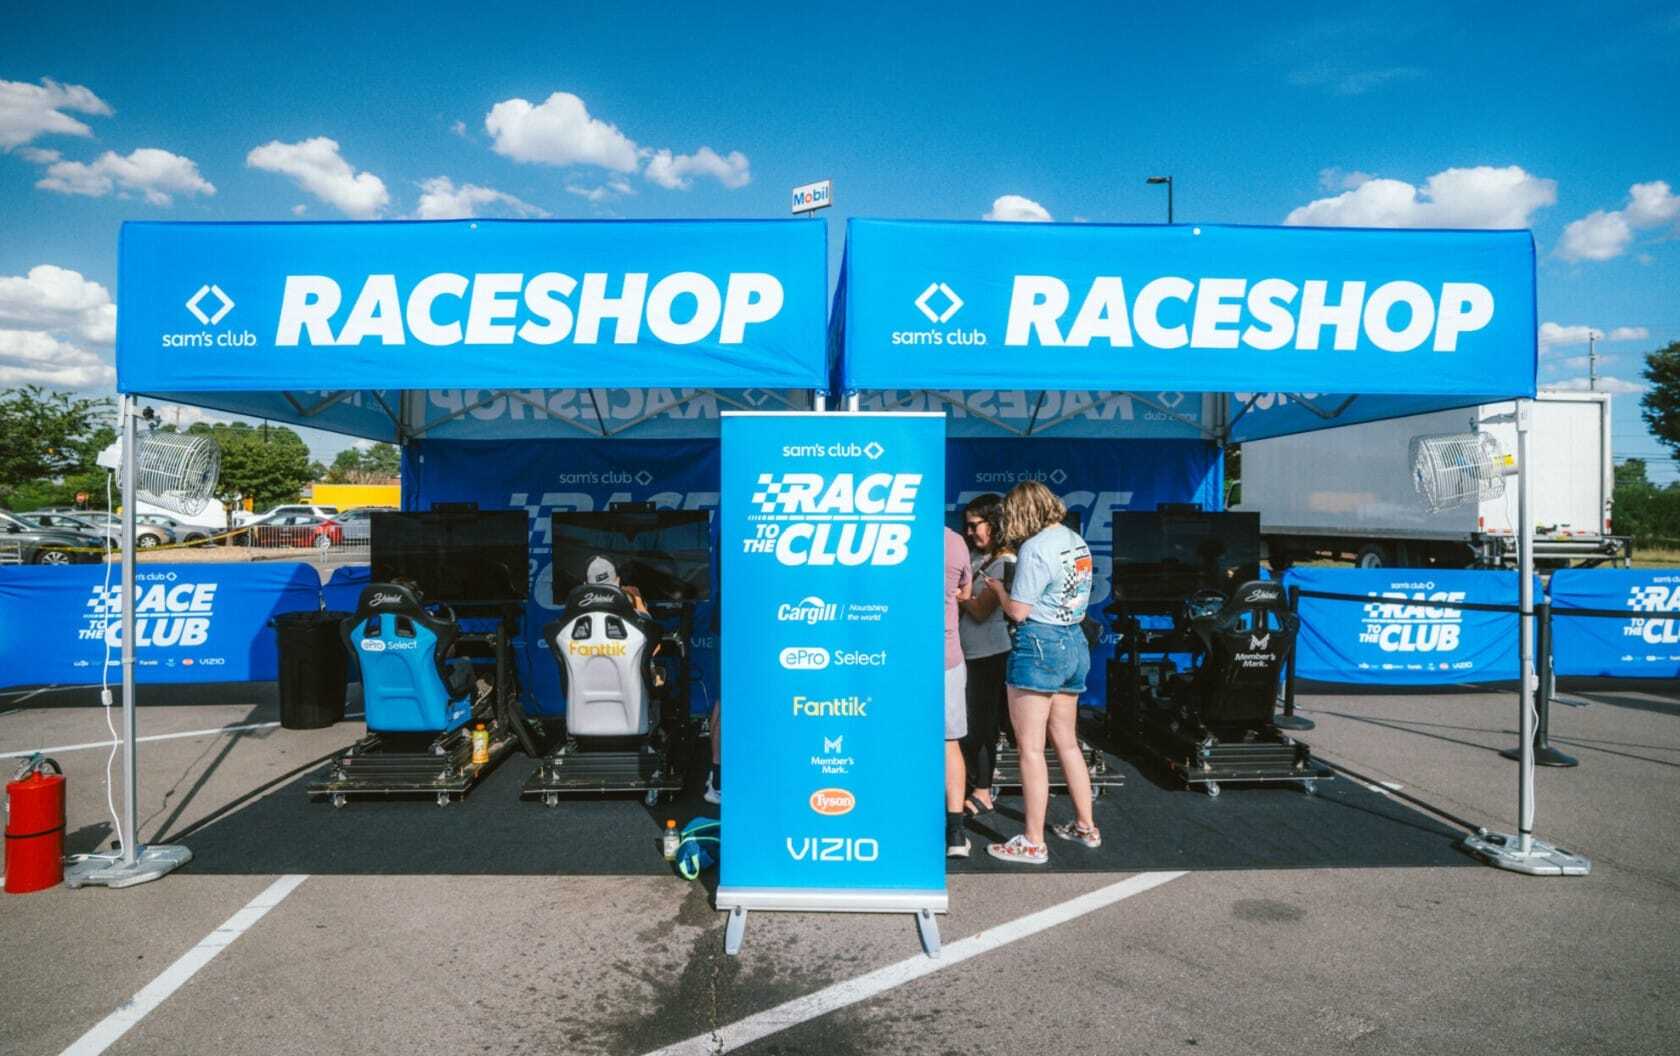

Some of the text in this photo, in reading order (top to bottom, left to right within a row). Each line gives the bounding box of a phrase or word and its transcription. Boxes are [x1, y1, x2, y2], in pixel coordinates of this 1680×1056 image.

[793, 186, 829, 206] Mobil
[275, 272, 784, 346] RACESHOP
[1004, 275, 1495, 353] RACESHOP
[162, 330, 257, 347] sam's club
[892, 328, 987, 345] sam's club
[783, 442, 862, 457] sam's club
[559, 469, 632, 485] sam's club
[976, 469, 1015, 483] sam's
[780, 473, 922, 514] RACE
[756, 524, 780, 538] TO
[743, 523, 911, 566] THE CLUB
[777, 602, 837, 625] Cargill
[1379, 624, 1461, 652] CLUB
[786, 649, 887, 667] ePro Select
[792, 696, 868, 718] Fanttik
[811, 756, 855, 766] Member's
[815, 793, 852, 809] Tyson
[786, 837, 879, 862] VIZIO
